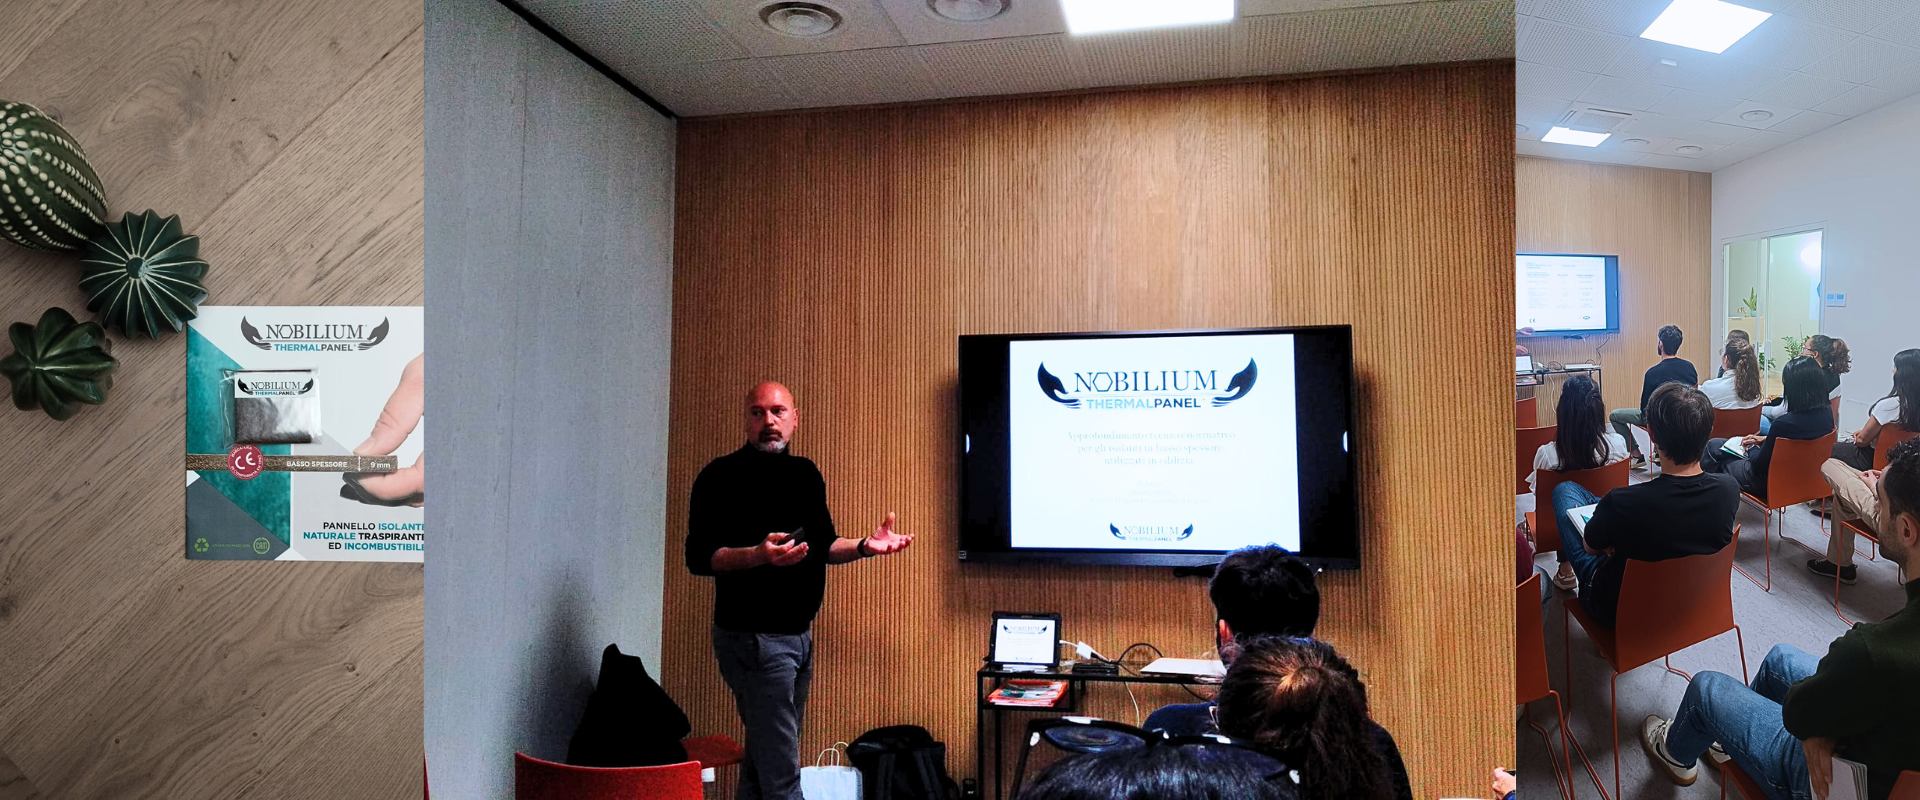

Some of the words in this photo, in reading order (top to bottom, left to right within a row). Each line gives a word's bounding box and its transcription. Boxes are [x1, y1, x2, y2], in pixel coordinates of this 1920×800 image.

[266, 324, 363, 339] NOBILIUM
[274, 343, 353, 352] THERMALPANEL
[1074, 370, 1217, 392] NOBILIUM
[1086, 398, 1201, 409] THERMALPANEL
[1095, 443, 1106, 452] gli
[323, 522, 376, 530] PANNELLO
[1124, 526, 1178, 535] NOBILIUM
[303, 532, 356, 540] NATURALE
[328, 542, 342, 550] ED
